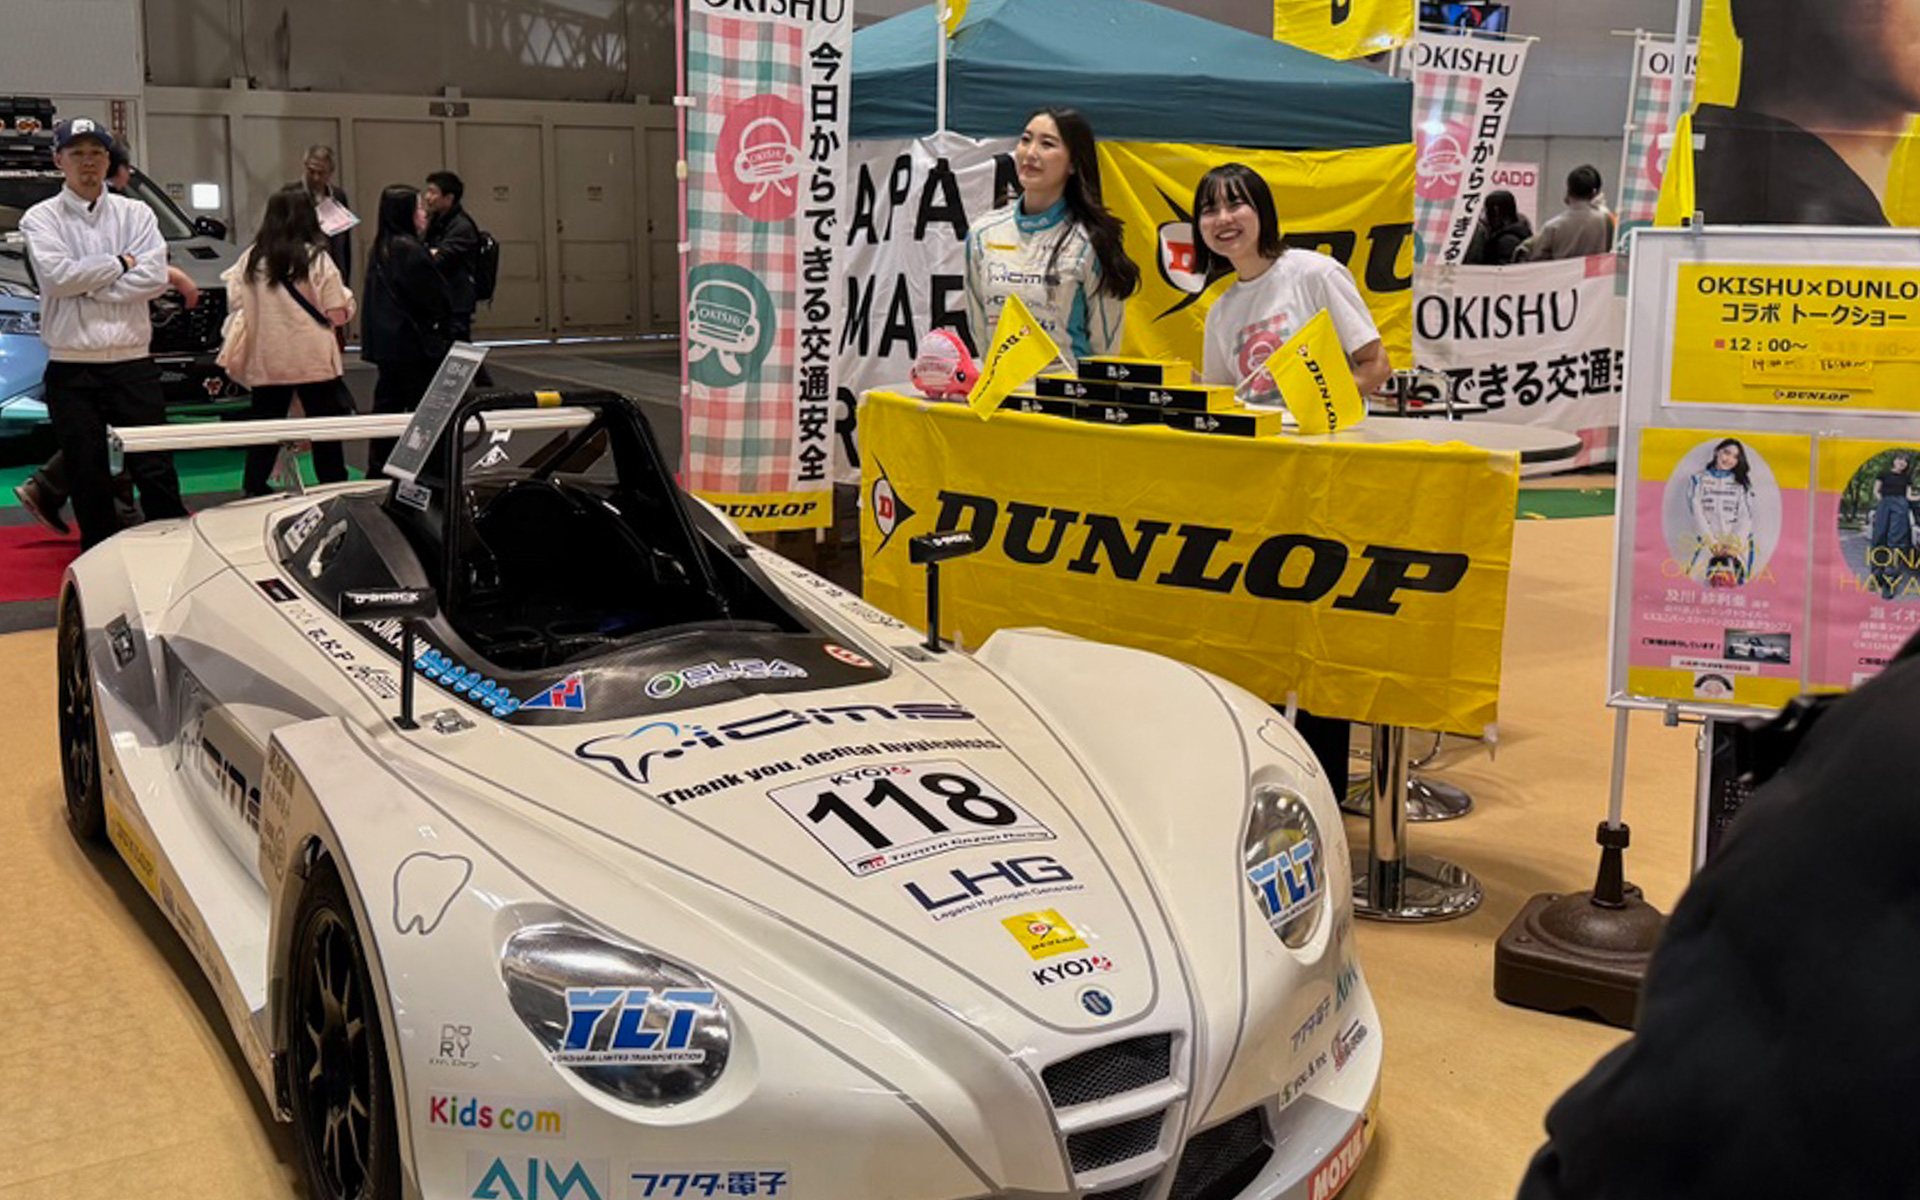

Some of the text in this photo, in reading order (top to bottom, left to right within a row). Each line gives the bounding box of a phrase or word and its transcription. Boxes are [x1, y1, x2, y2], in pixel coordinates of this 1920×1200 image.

[702, 0, 845, 24] SHU
[1411, 43, 1519, 77] OKISHU
[798, 41, 843, 482] 今日からできる交通安全
[1416, 288, 1579, 340] OKISHU
[1721, 303, 1907, 327] コラボ トークショー
[934, 490, 1470, 616] DUNLOP
[657, 773, 744, 807] Thank
[744, 755, 803, 784] you,
[806, 772, 1018, 850] 118
[903, 856, 1074, 912] LHG
[1248, 838, 1318, 916] YLT
[565, 988, 718, 1051] YLT
[430, 1096, 561, 1134] Kids com
[631, 1171, 787, 1197] フクダ電子
